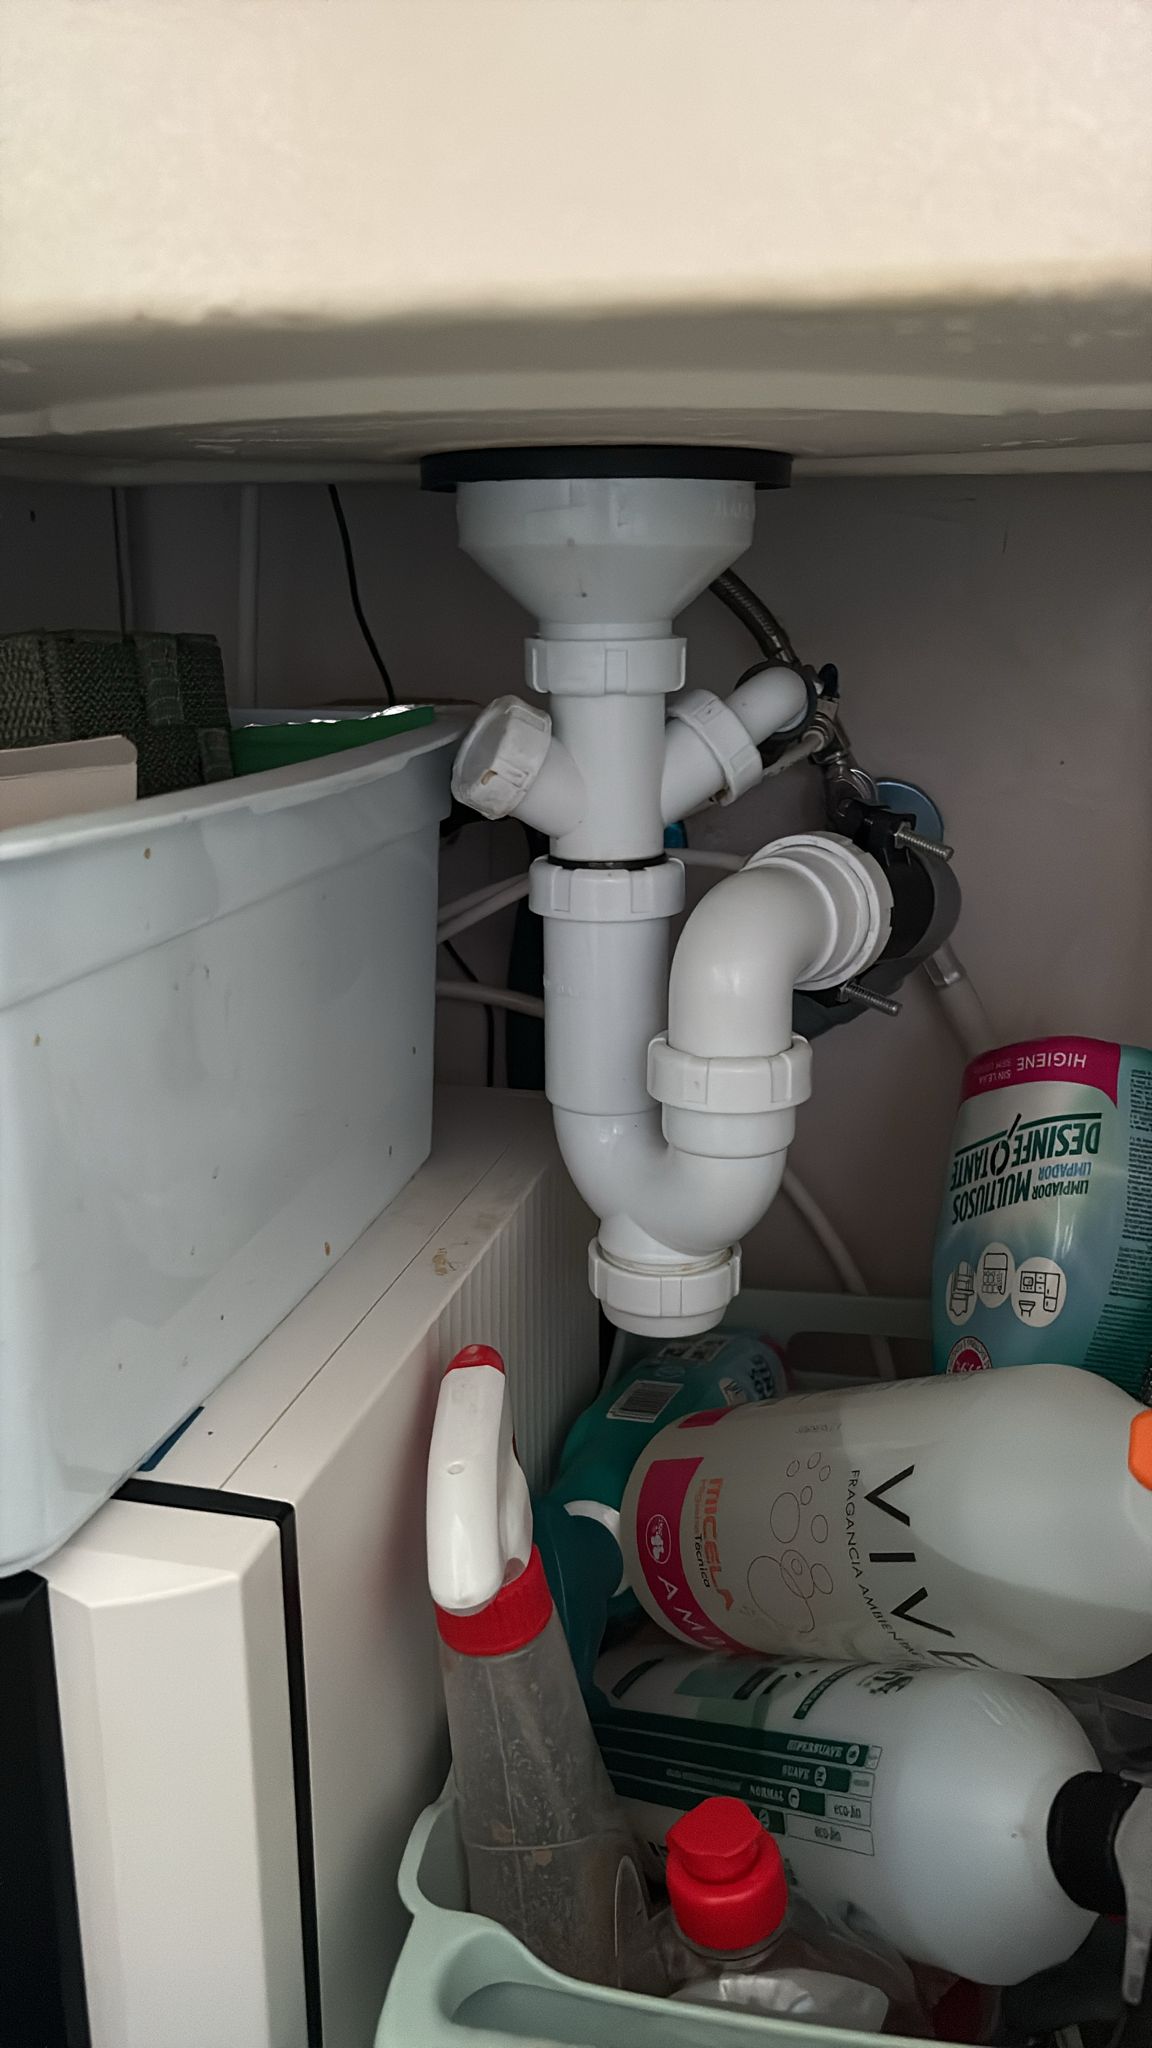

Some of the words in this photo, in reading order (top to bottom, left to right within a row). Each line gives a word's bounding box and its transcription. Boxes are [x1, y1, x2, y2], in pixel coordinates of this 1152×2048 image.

[1016, 1052, 1087, 1072] HIGIENE
[1038, 1161, 1092, 1181] LIMPADOR
[952, 1168, 1032, 1225] MULTIUSOS
[1032, 1179, 1089, 1200] LIMPIADOR
[845, 1469, 863, 1578] FRAGANCIA
[750, 1785, 785, 1802] NORMAL
